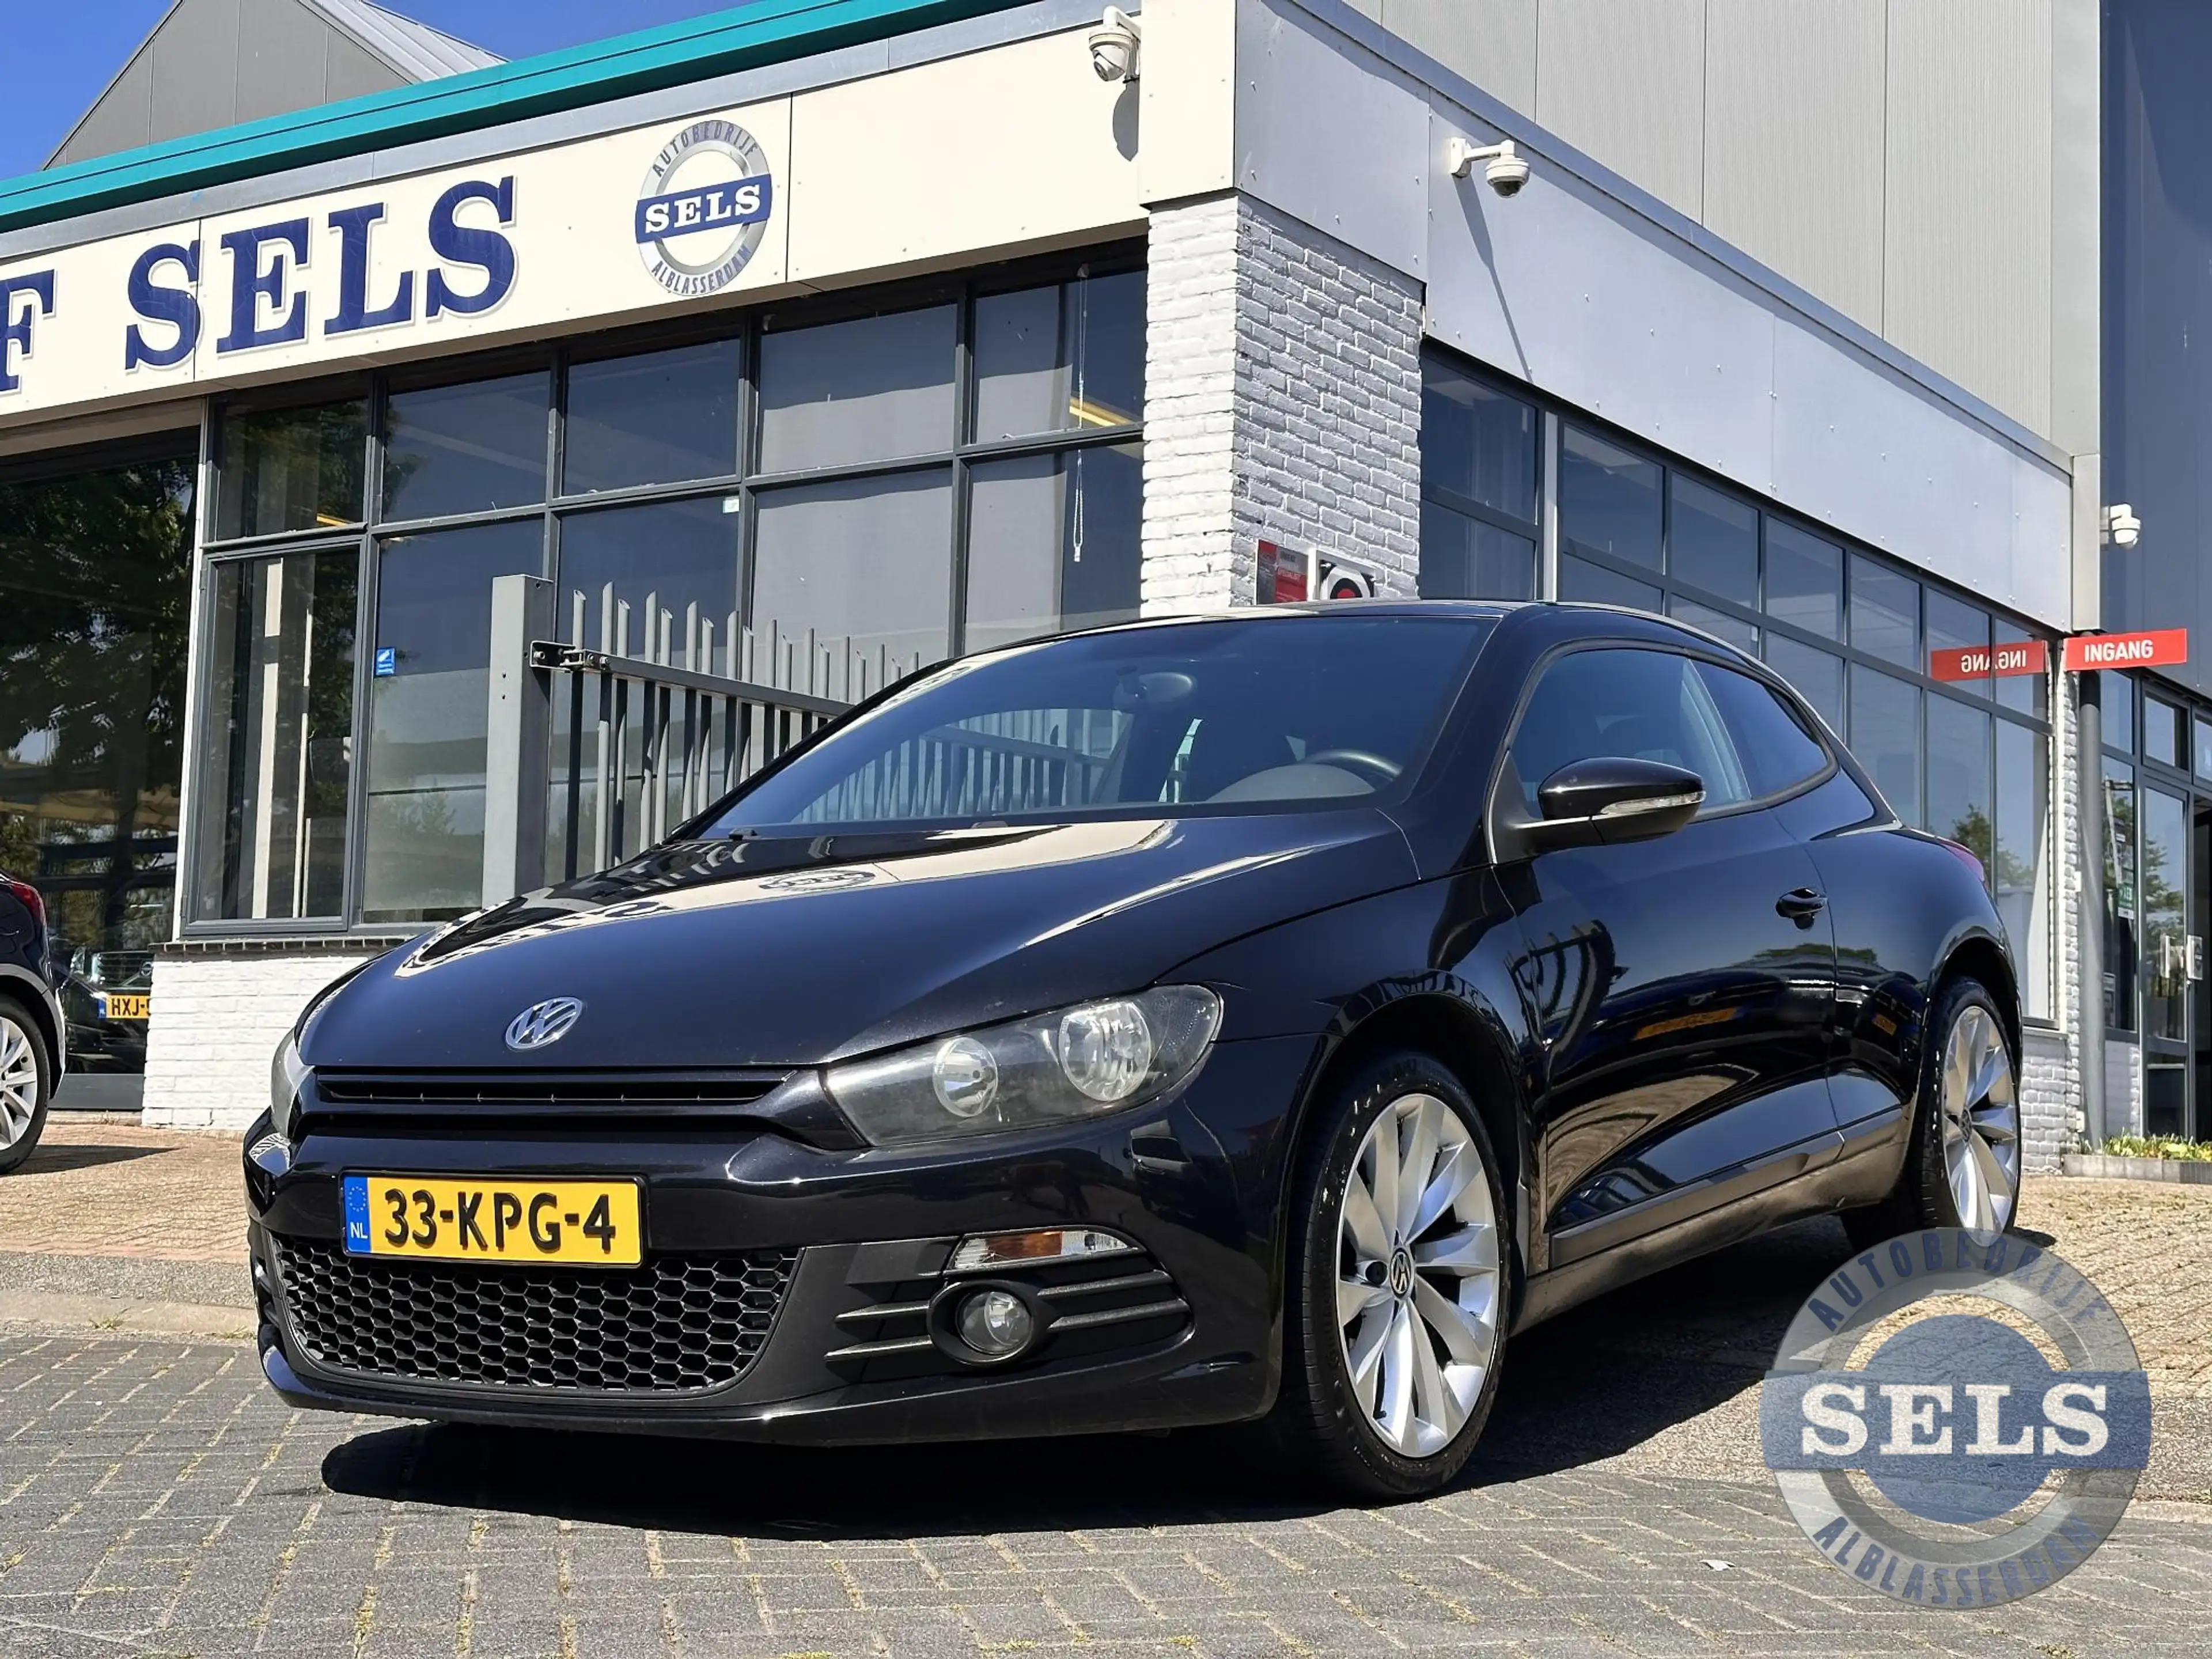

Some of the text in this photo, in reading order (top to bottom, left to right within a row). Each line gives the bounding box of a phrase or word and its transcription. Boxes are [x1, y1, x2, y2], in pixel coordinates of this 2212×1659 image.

[653, 122, 758, 177] AUTOBEDRIJF
[645, 184, 760, 233] SELS
[125, 176, 516, 369] SELS
[651, 245, 752, 294] ALBLASSERDAM
[2085, 639, 2153, 661] INGANG
[350, 1222, 368, 1239] NL
[384, 1188, 616, 1254] 33-KPG-4
